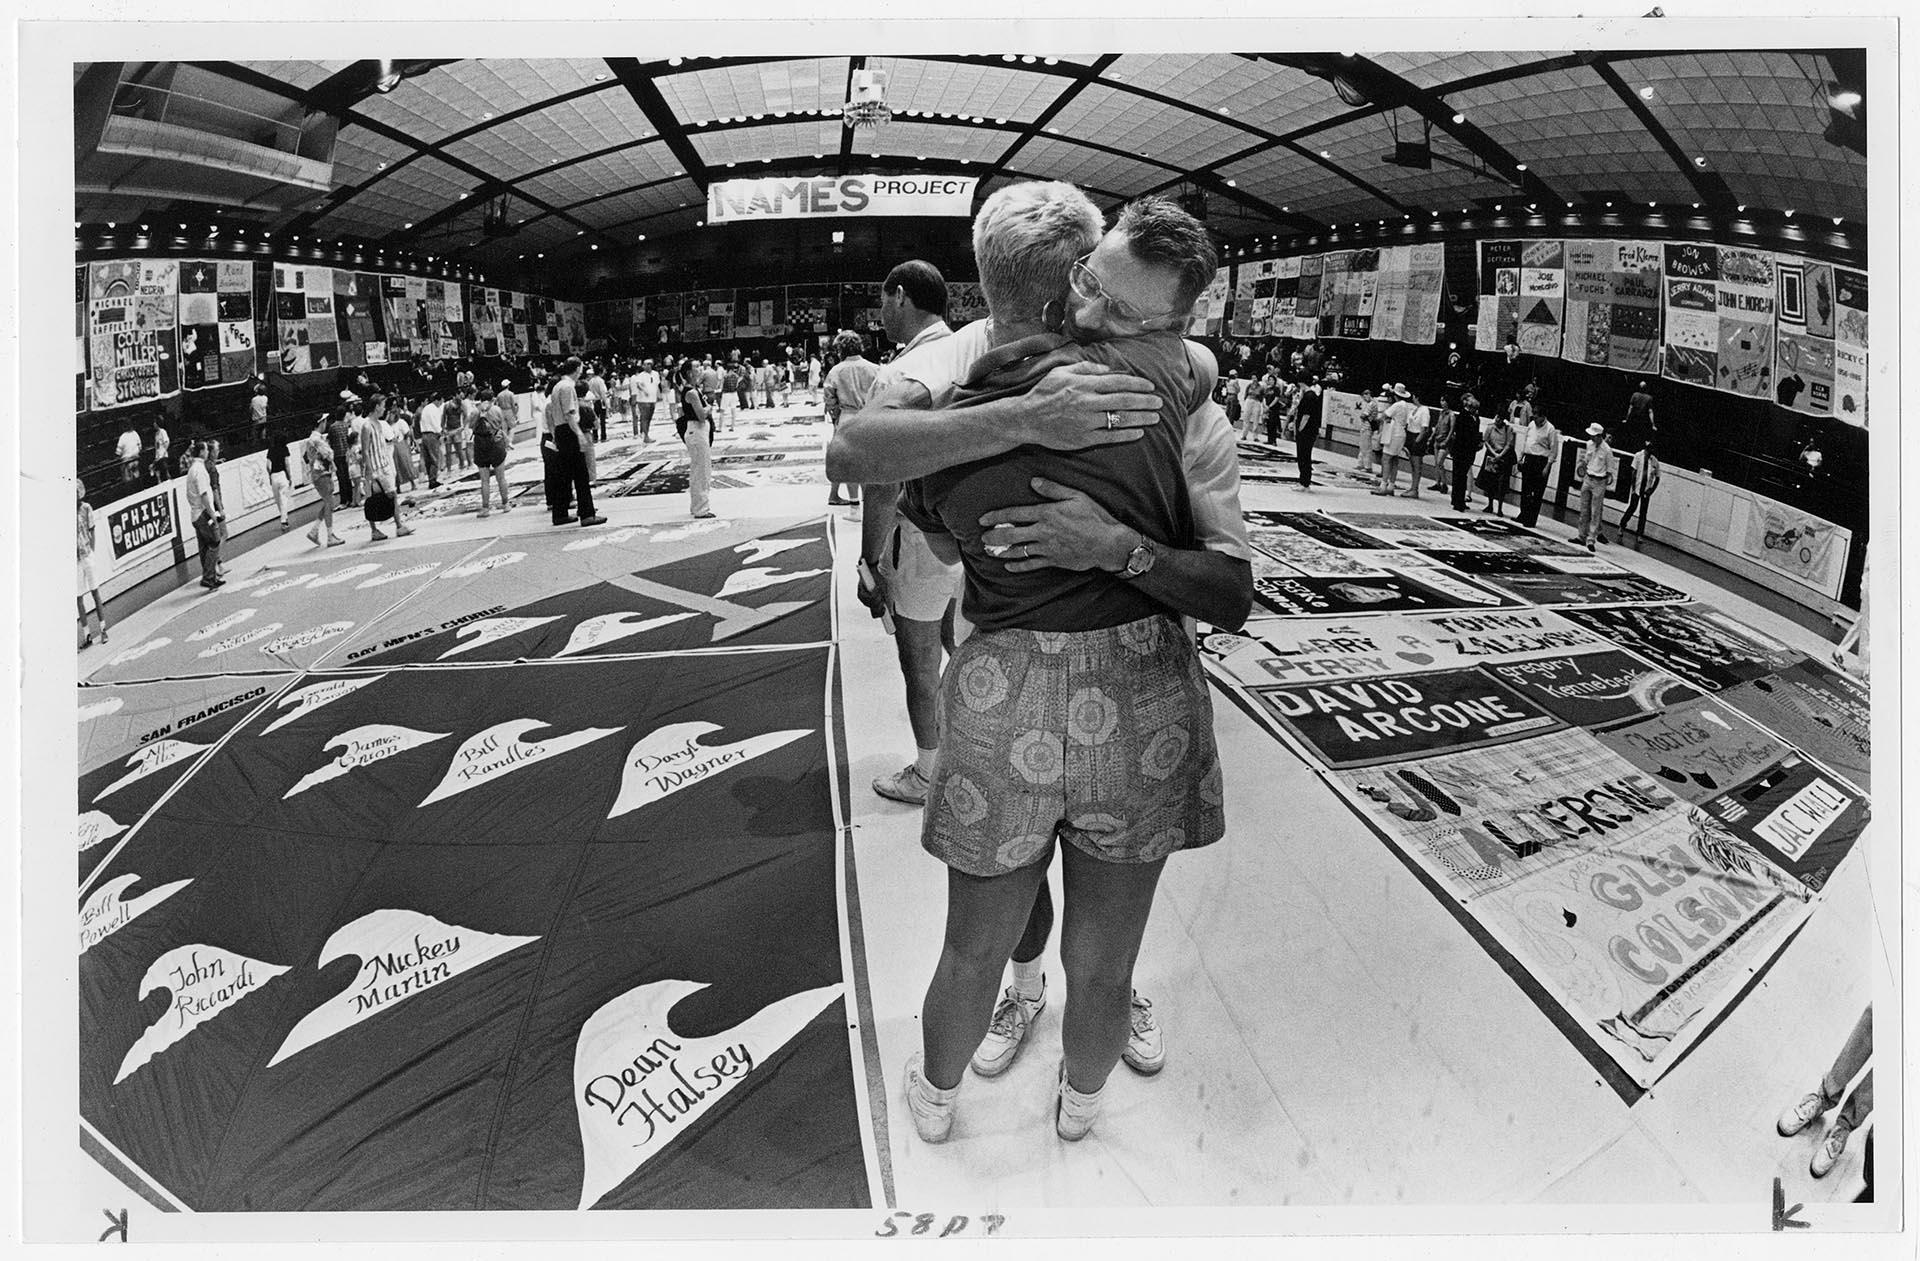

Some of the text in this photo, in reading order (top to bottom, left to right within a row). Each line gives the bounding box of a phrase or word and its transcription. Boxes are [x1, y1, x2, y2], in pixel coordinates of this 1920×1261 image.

[714, 179, 971, 216] NAMES PROJECT
[1672, 259, 1711, 276] BROWER
[1682, 247, 1700, 259] JON
[118, 331, 153, 348] COURT
[229, 323, 251, 348] FRED
[116, 346, 156, 368] MILLER
[121, 501, 159, 531] PHIL
[124, 519, 160, 550] BUNDY
[347, 644, 378, 660] GAY
[383, 627, 435, 648] MEN'S
[440, 604, 507, 630] CHORUS
[1429, 615, 1544, 634] TOMMY
[1258, 637, 1382, 656] LARRY
[1255, 657, 1392, 680] PERRY
[140, 686, 266, 745] SAN FRANCISCO
[1260, 680, 1425, 717] DAVID
[1335, 695, 1527, 742] ARCONE
[1624, 719, 1711, 751] Charles
[457, 743, 546, 781] Randles
[459, 734, 500, 762] Bill
[634, 739, 699, 773] Daryl
[645, 748, 746, 792] Wagner
[1792, 784, 1847, 825] WALL
[1767, 809, 1815, 856] JAC
[80, 903, 131, 949] Powell
[82, 893, 113, 926] Bill
[1607, 878, 1768, 986] COLSON
[169, 951, 225, 992] John
[363, 934, 461, 990] Mickey
[174, 960, 256, 1029] Riccardi
[347, 961, 452, 1015] Martin
[584, 1037, 682, 1113] Dean
[616, 1039, 755, 1148] Halsey
